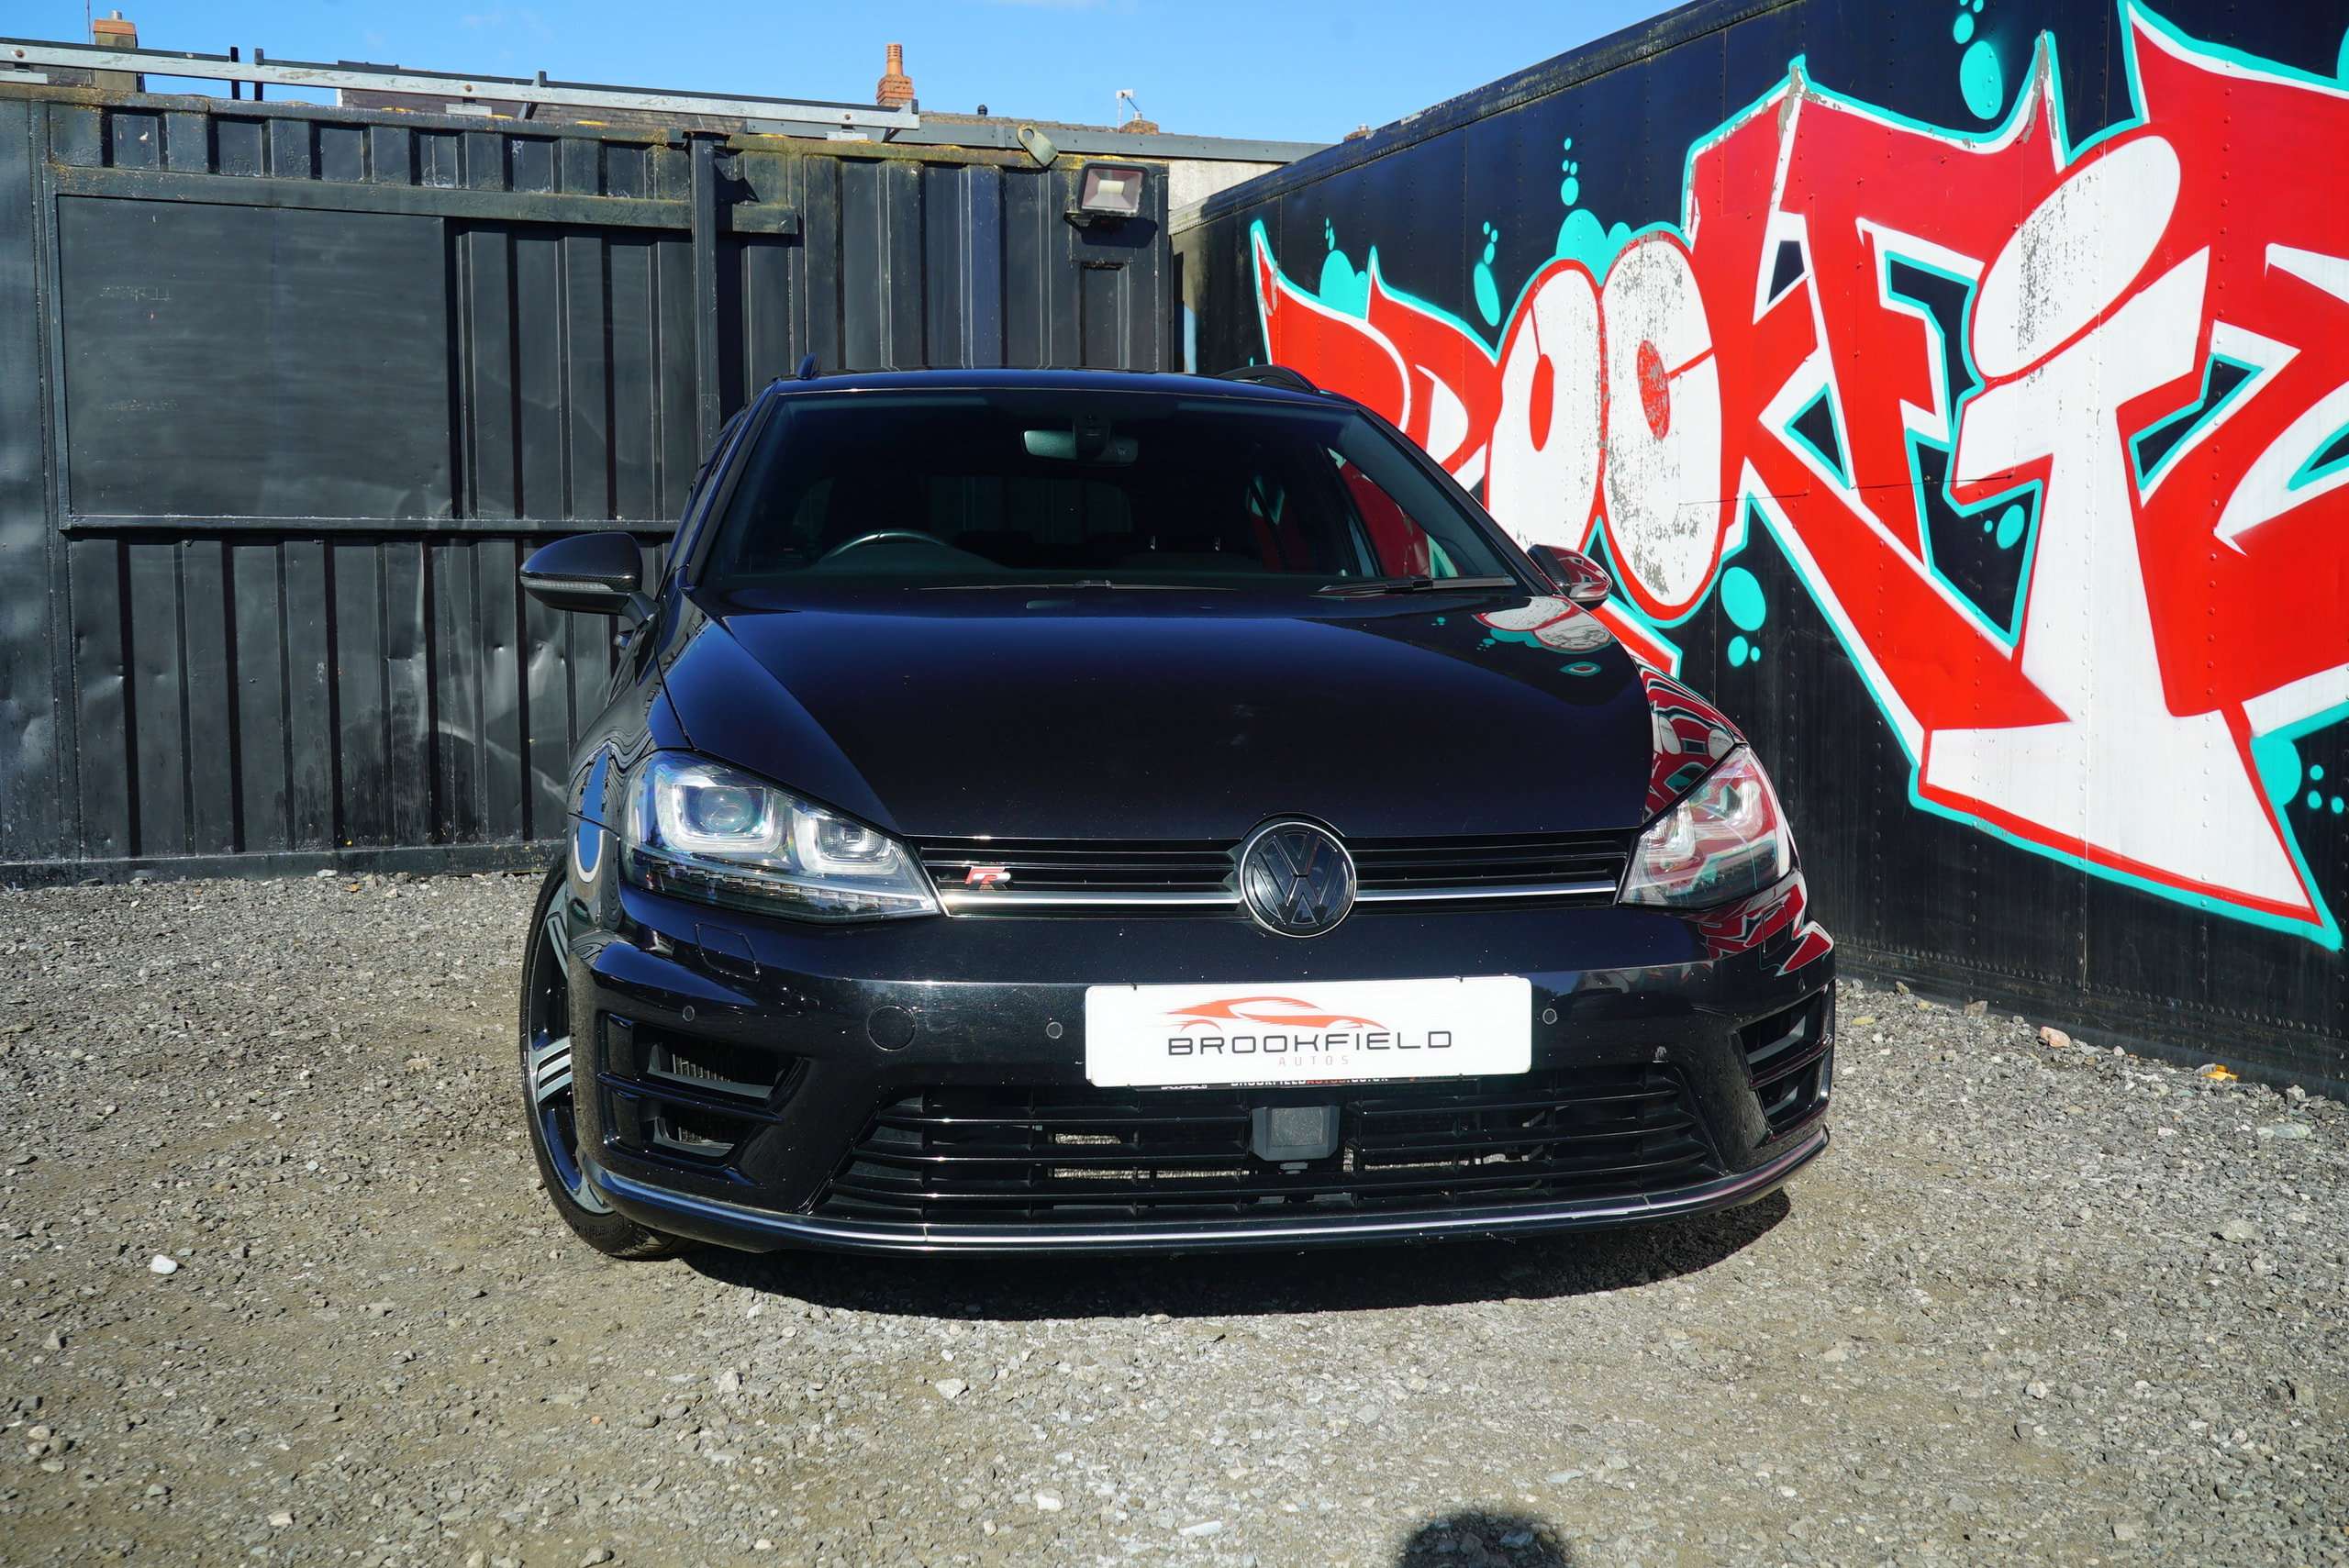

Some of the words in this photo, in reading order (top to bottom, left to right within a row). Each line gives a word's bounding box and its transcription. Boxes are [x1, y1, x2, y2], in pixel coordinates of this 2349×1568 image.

[964, 866, 1010, 890] R
[1245, 825, 1353, 933] VW
[1168, 1031, 1453, 1055] BROOKFIELD
[1278, 1055, 1350, 1067] AUTOS
